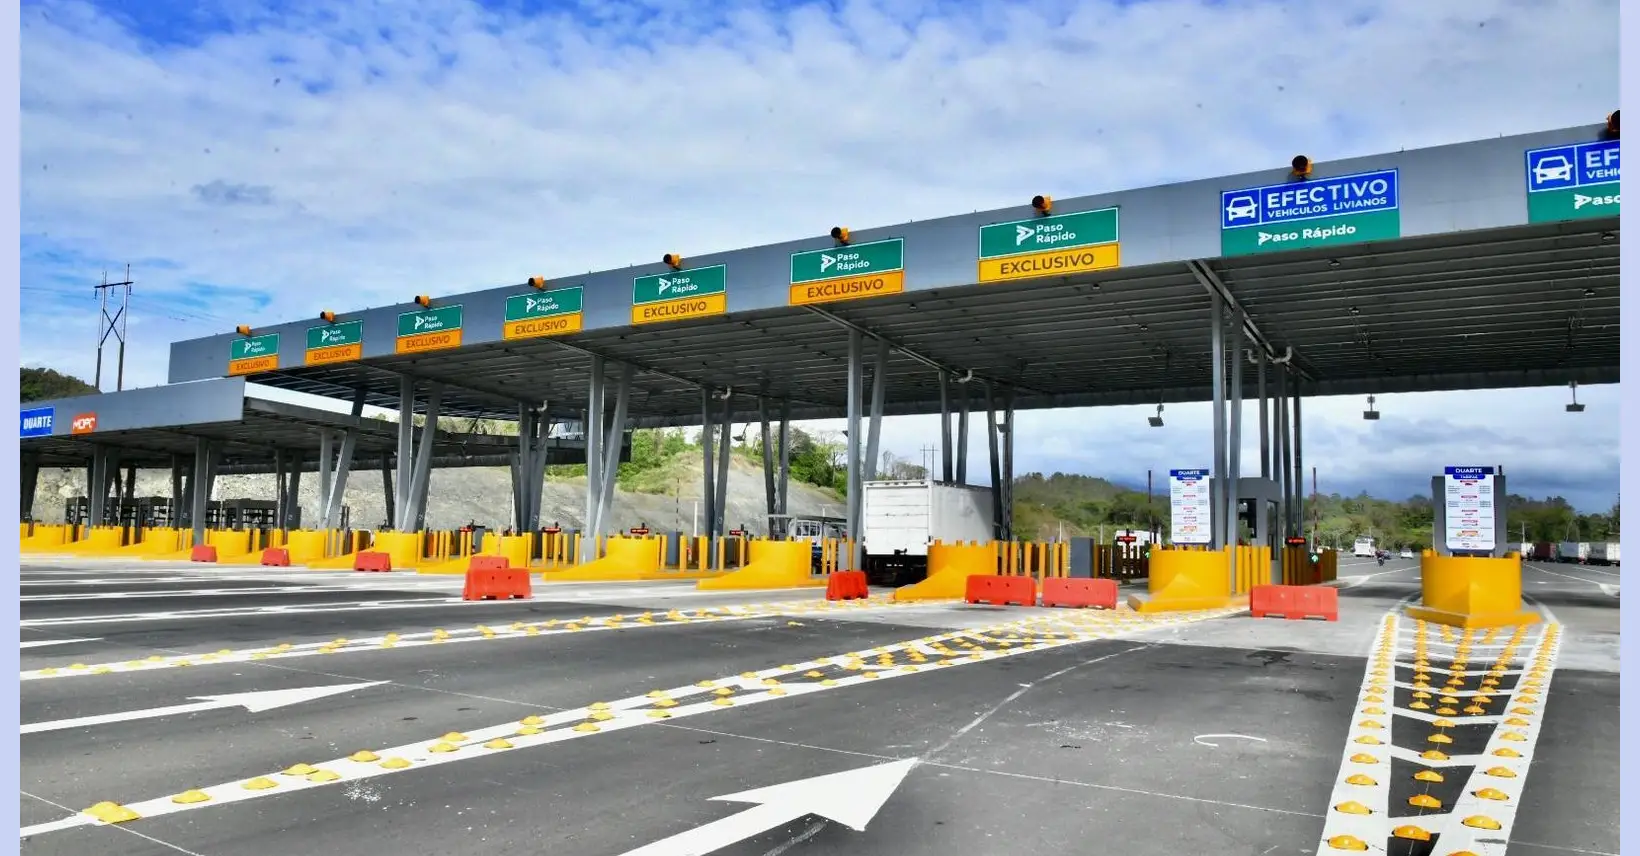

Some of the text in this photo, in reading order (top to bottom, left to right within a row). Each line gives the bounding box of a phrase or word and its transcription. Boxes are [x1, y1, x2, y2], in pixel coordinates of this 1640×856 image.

[1267, 178, 1388, 209] EFECTIVO
[1267, 196, 1387, 218] VEHICULOS LIVIANOS
[1036, 223, 1064, 233] Paso
[1302, 224, 1356, 241] Rápido
[1036, 231, 1076, 244] Rápido
[837, 252, 859, 262] Paso
[1000, 252, 1094, 275] EXCLUSIVO
[836, 259, 870, 271] Rápido
[672, 277, 690, 285] Paso
[672, 283, 698, 294] Rápido
[807, 278, 884, 299] EXCLUSIVO
[537, 303, 559, 312] Rápido
[644, 301, 707, 318] EXCLUSIVO
[424, 315, 437, 323] Paso
[515, 319, 568, 335] EXCLUSIVO
[406, 334, 450, 348] EXCLUSIVO
[313, 348, 351, 361] EXCLUSIVO
[235, 359, 270, 371] EXCLUSIVO
[23, 415, 52, 430] DUARTE
